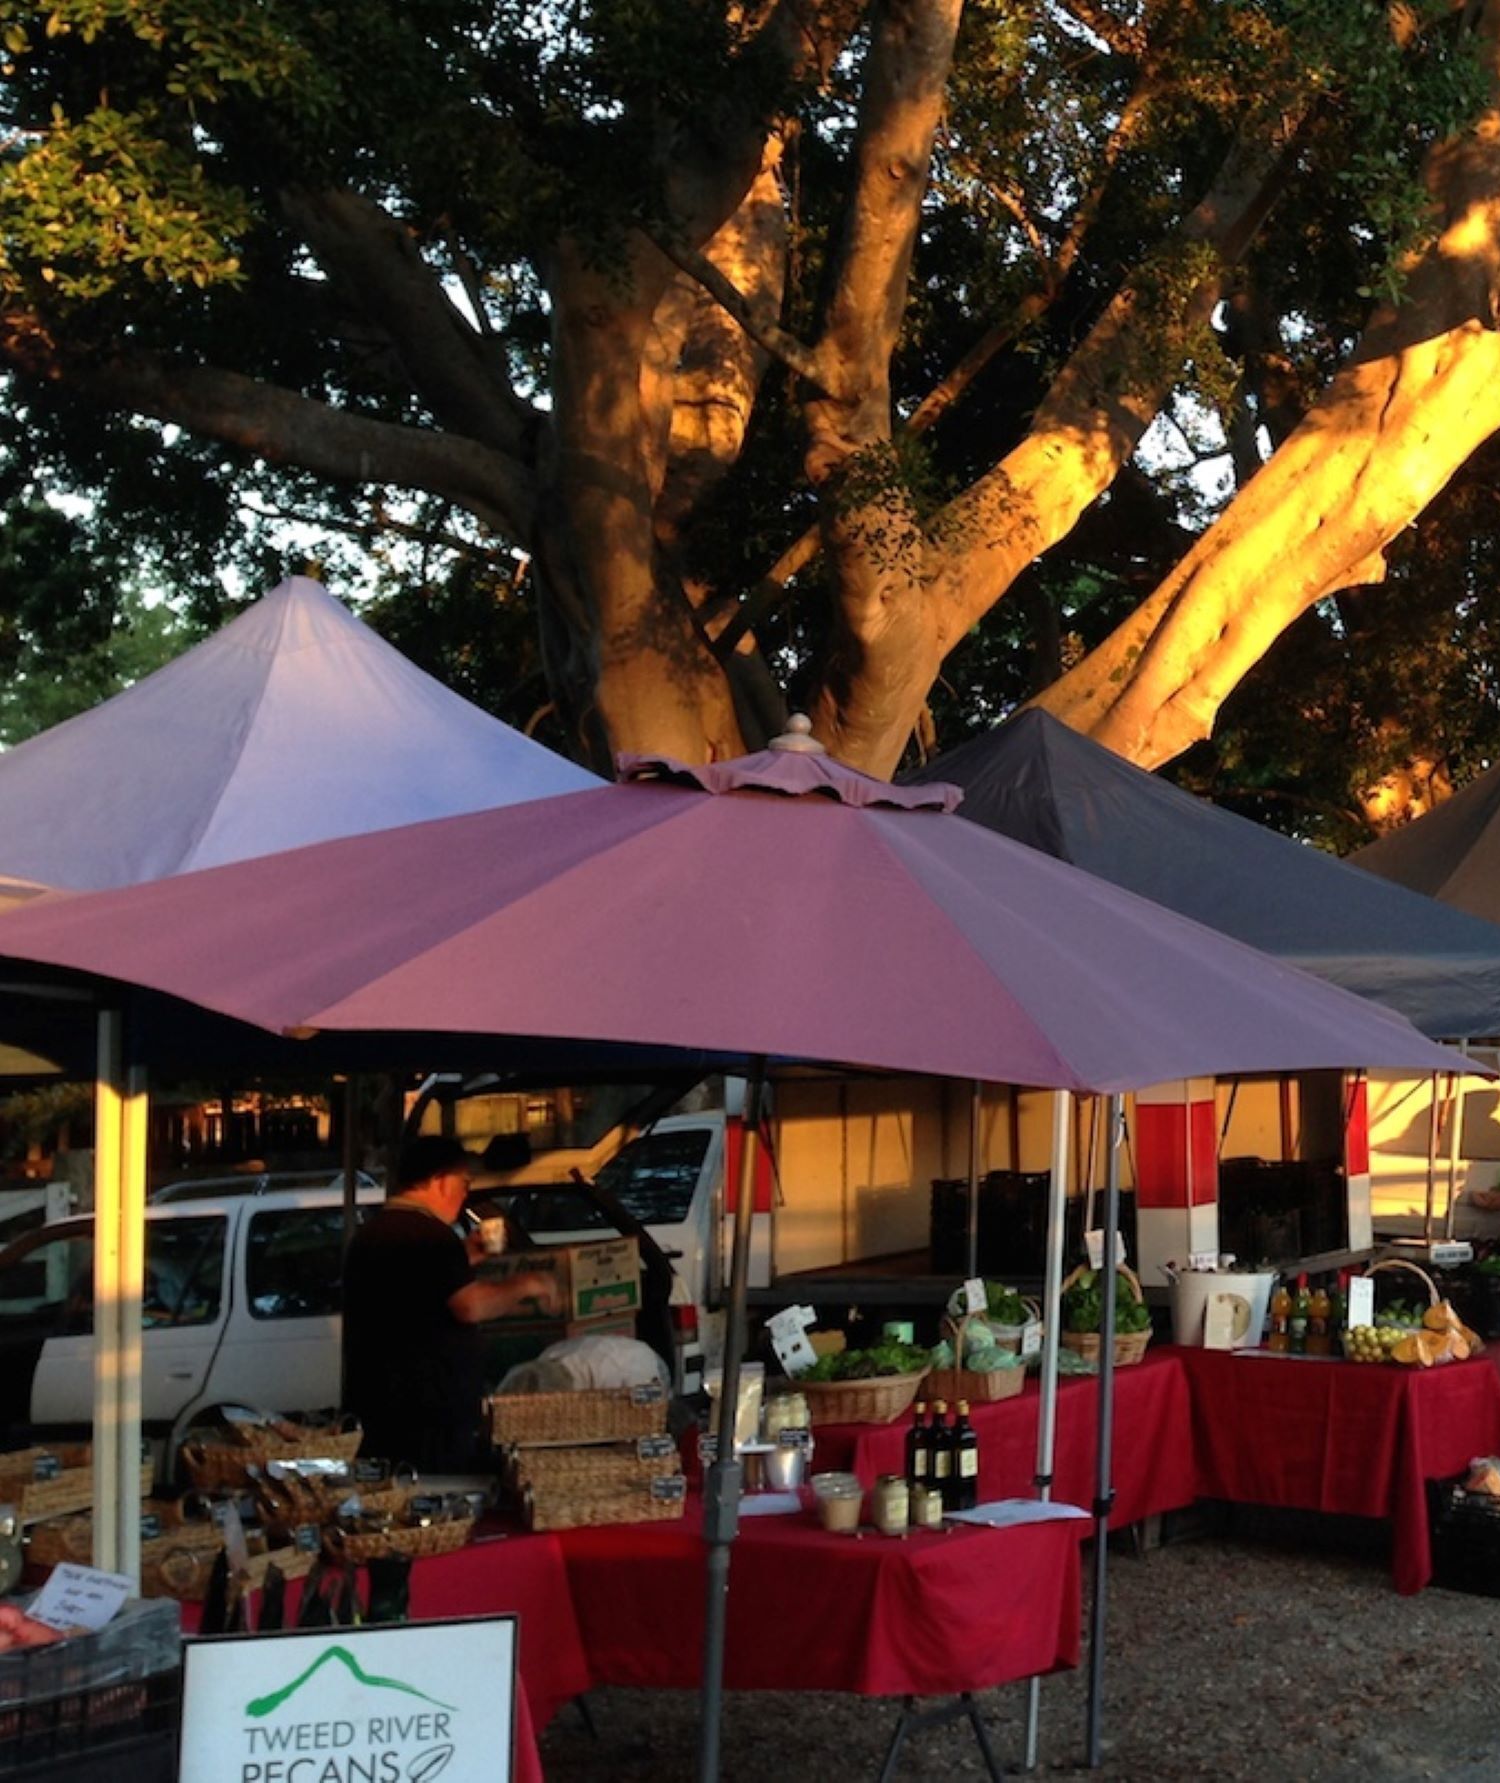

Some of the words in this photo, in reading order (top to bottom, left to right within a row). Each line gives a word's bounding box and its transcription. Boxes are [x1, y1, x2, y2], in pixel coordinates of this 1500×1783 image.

[243, 1721, 355, 1754] TWEED
[367, 1712, 452, 1746] RIVER
[242, 1751, 401, 1783] PECANS
